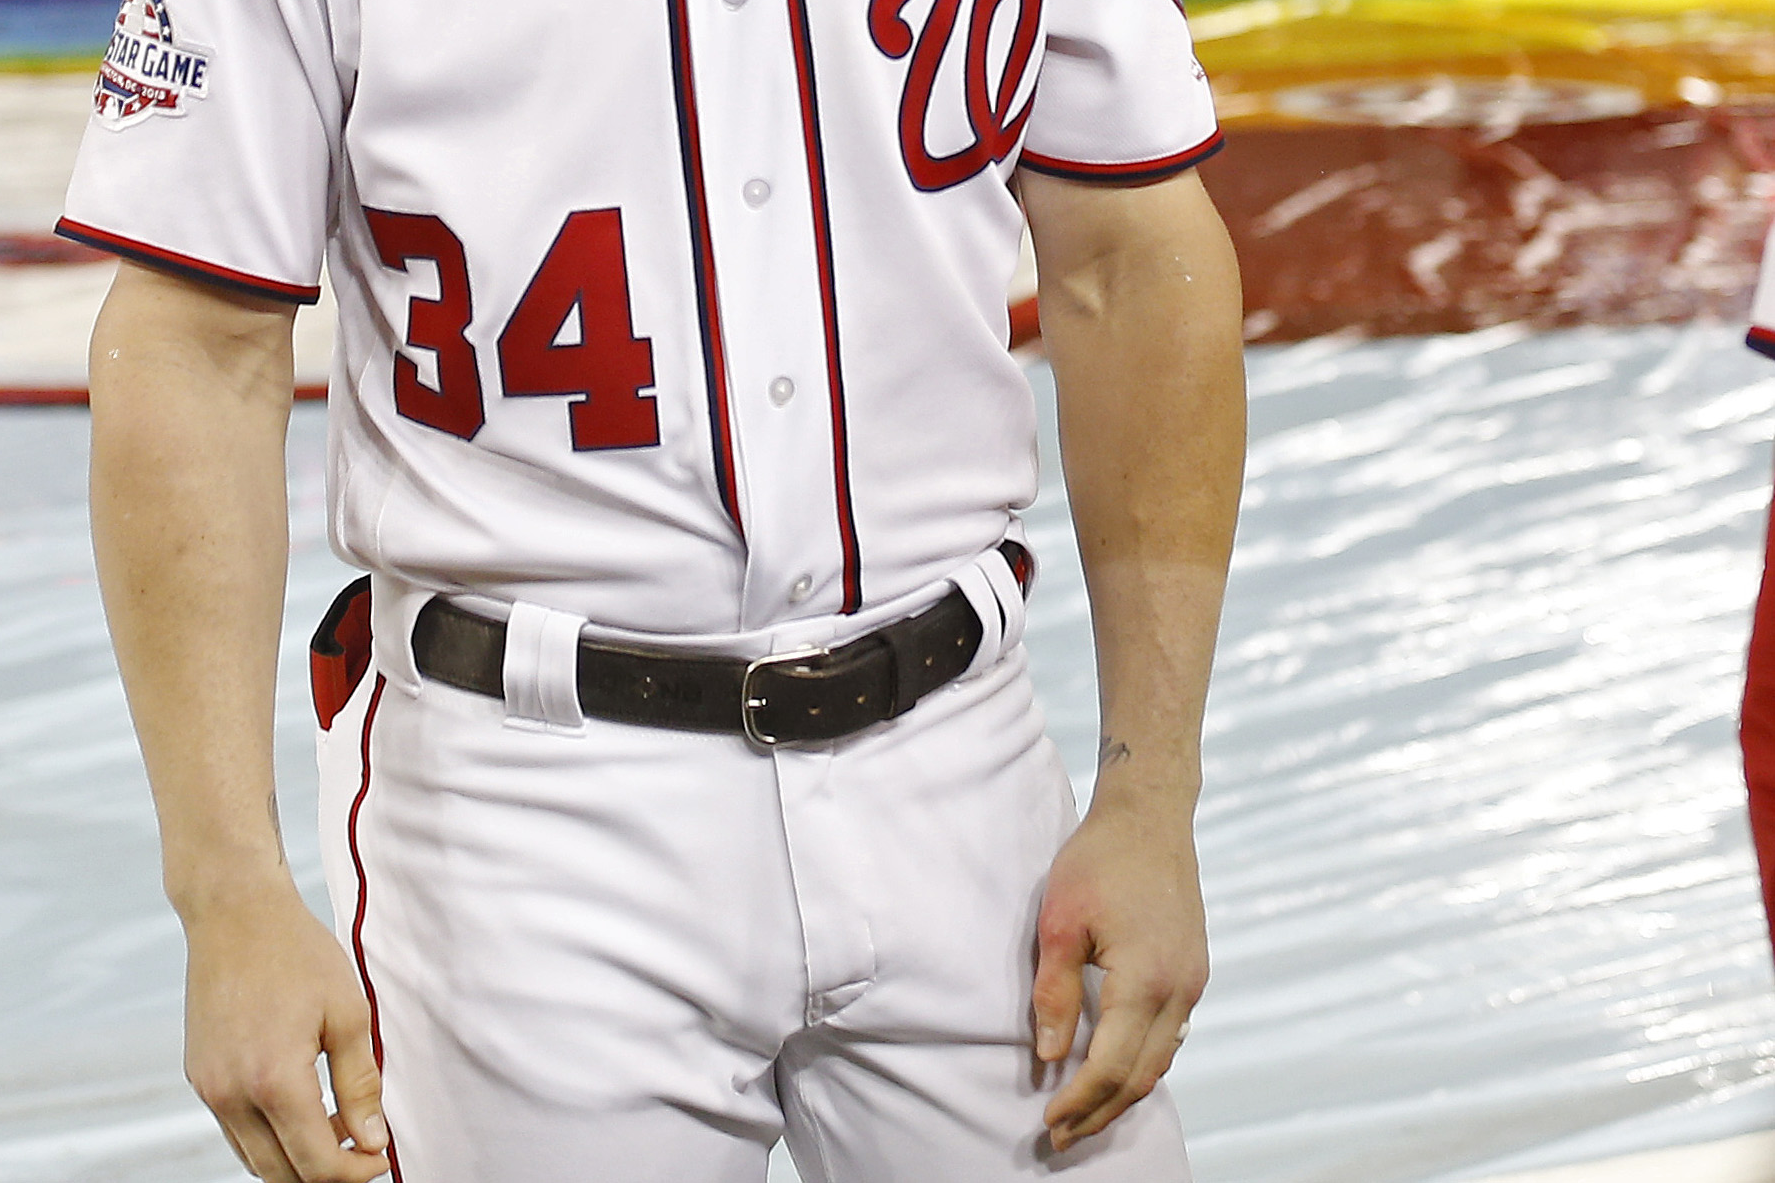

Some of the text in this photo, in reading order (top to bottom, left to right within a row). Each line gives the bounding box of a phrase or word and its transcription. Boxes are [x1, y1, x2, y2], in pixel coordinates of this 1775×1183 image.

[142, 43, 206, 89] GAME
[141, 86, 166, 101] 2018
[361, 205, 661, 452] 34
